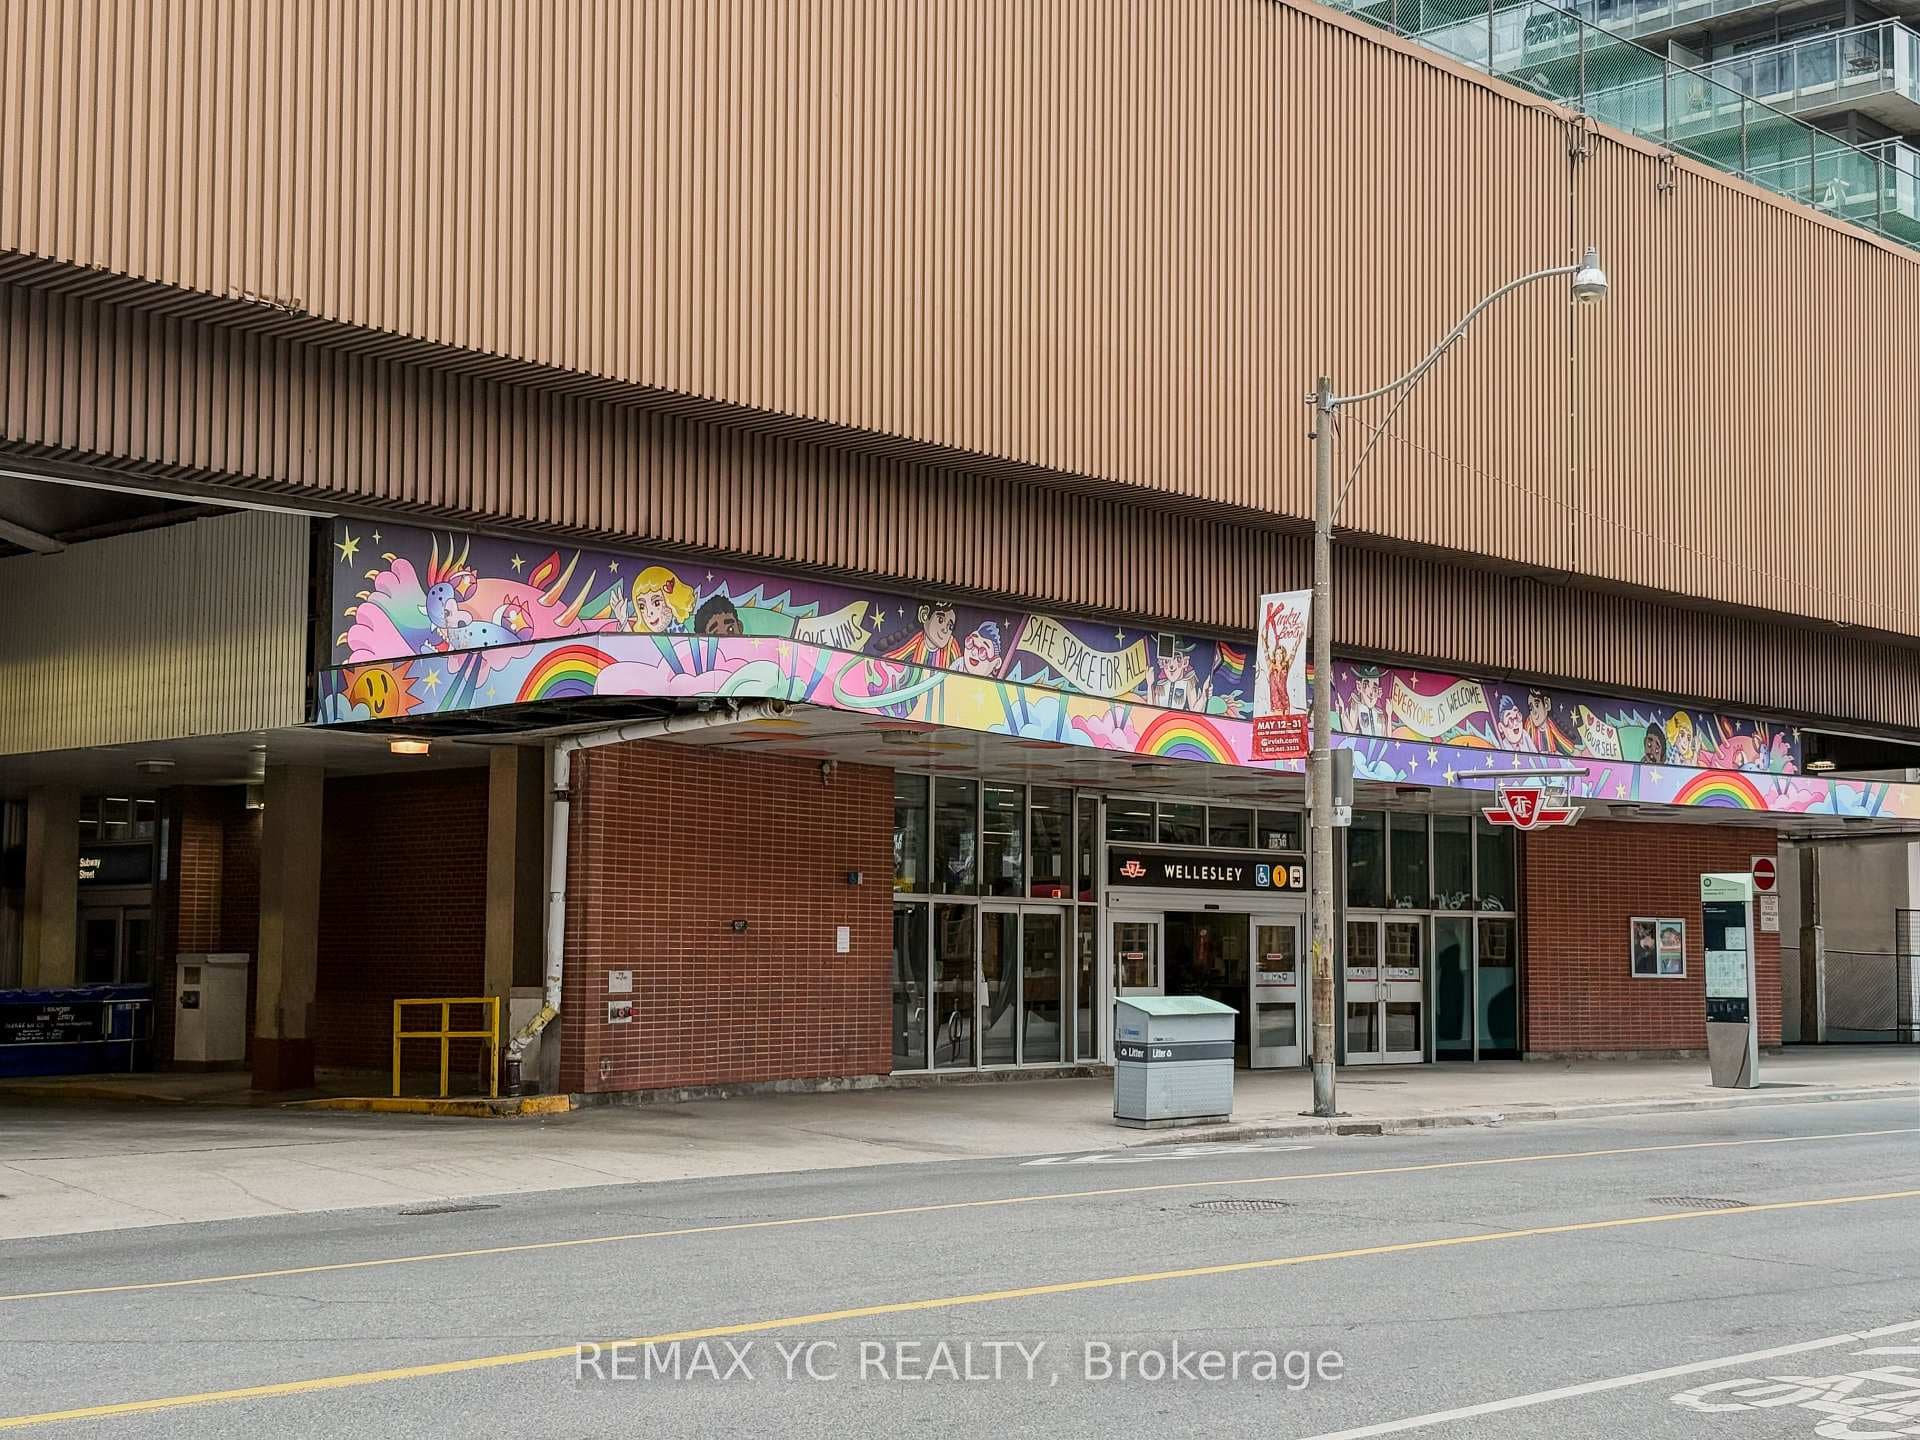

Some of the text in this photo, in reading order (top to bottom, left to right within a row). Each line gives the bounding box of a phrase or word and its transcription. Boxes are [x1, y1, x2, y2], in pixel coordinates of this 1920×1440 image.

[829, 613, 863, 649] WINS
[1022, 616, 1145, 690] SAFE SPACE FOR ALL
[1393, 682, 1482, 727] EVERYONE IS WELCOME
[1257, 720, 1275, 730] MAY
[1596, 720, 1605, 735] BE
[1585, 725, 1617, 757] YOURSELF
[80, 857, 101, 869] Subway
[1164, 864, 1242, 881] WELLESLEY
[1128, 1048, 1145, 1058] Litter
